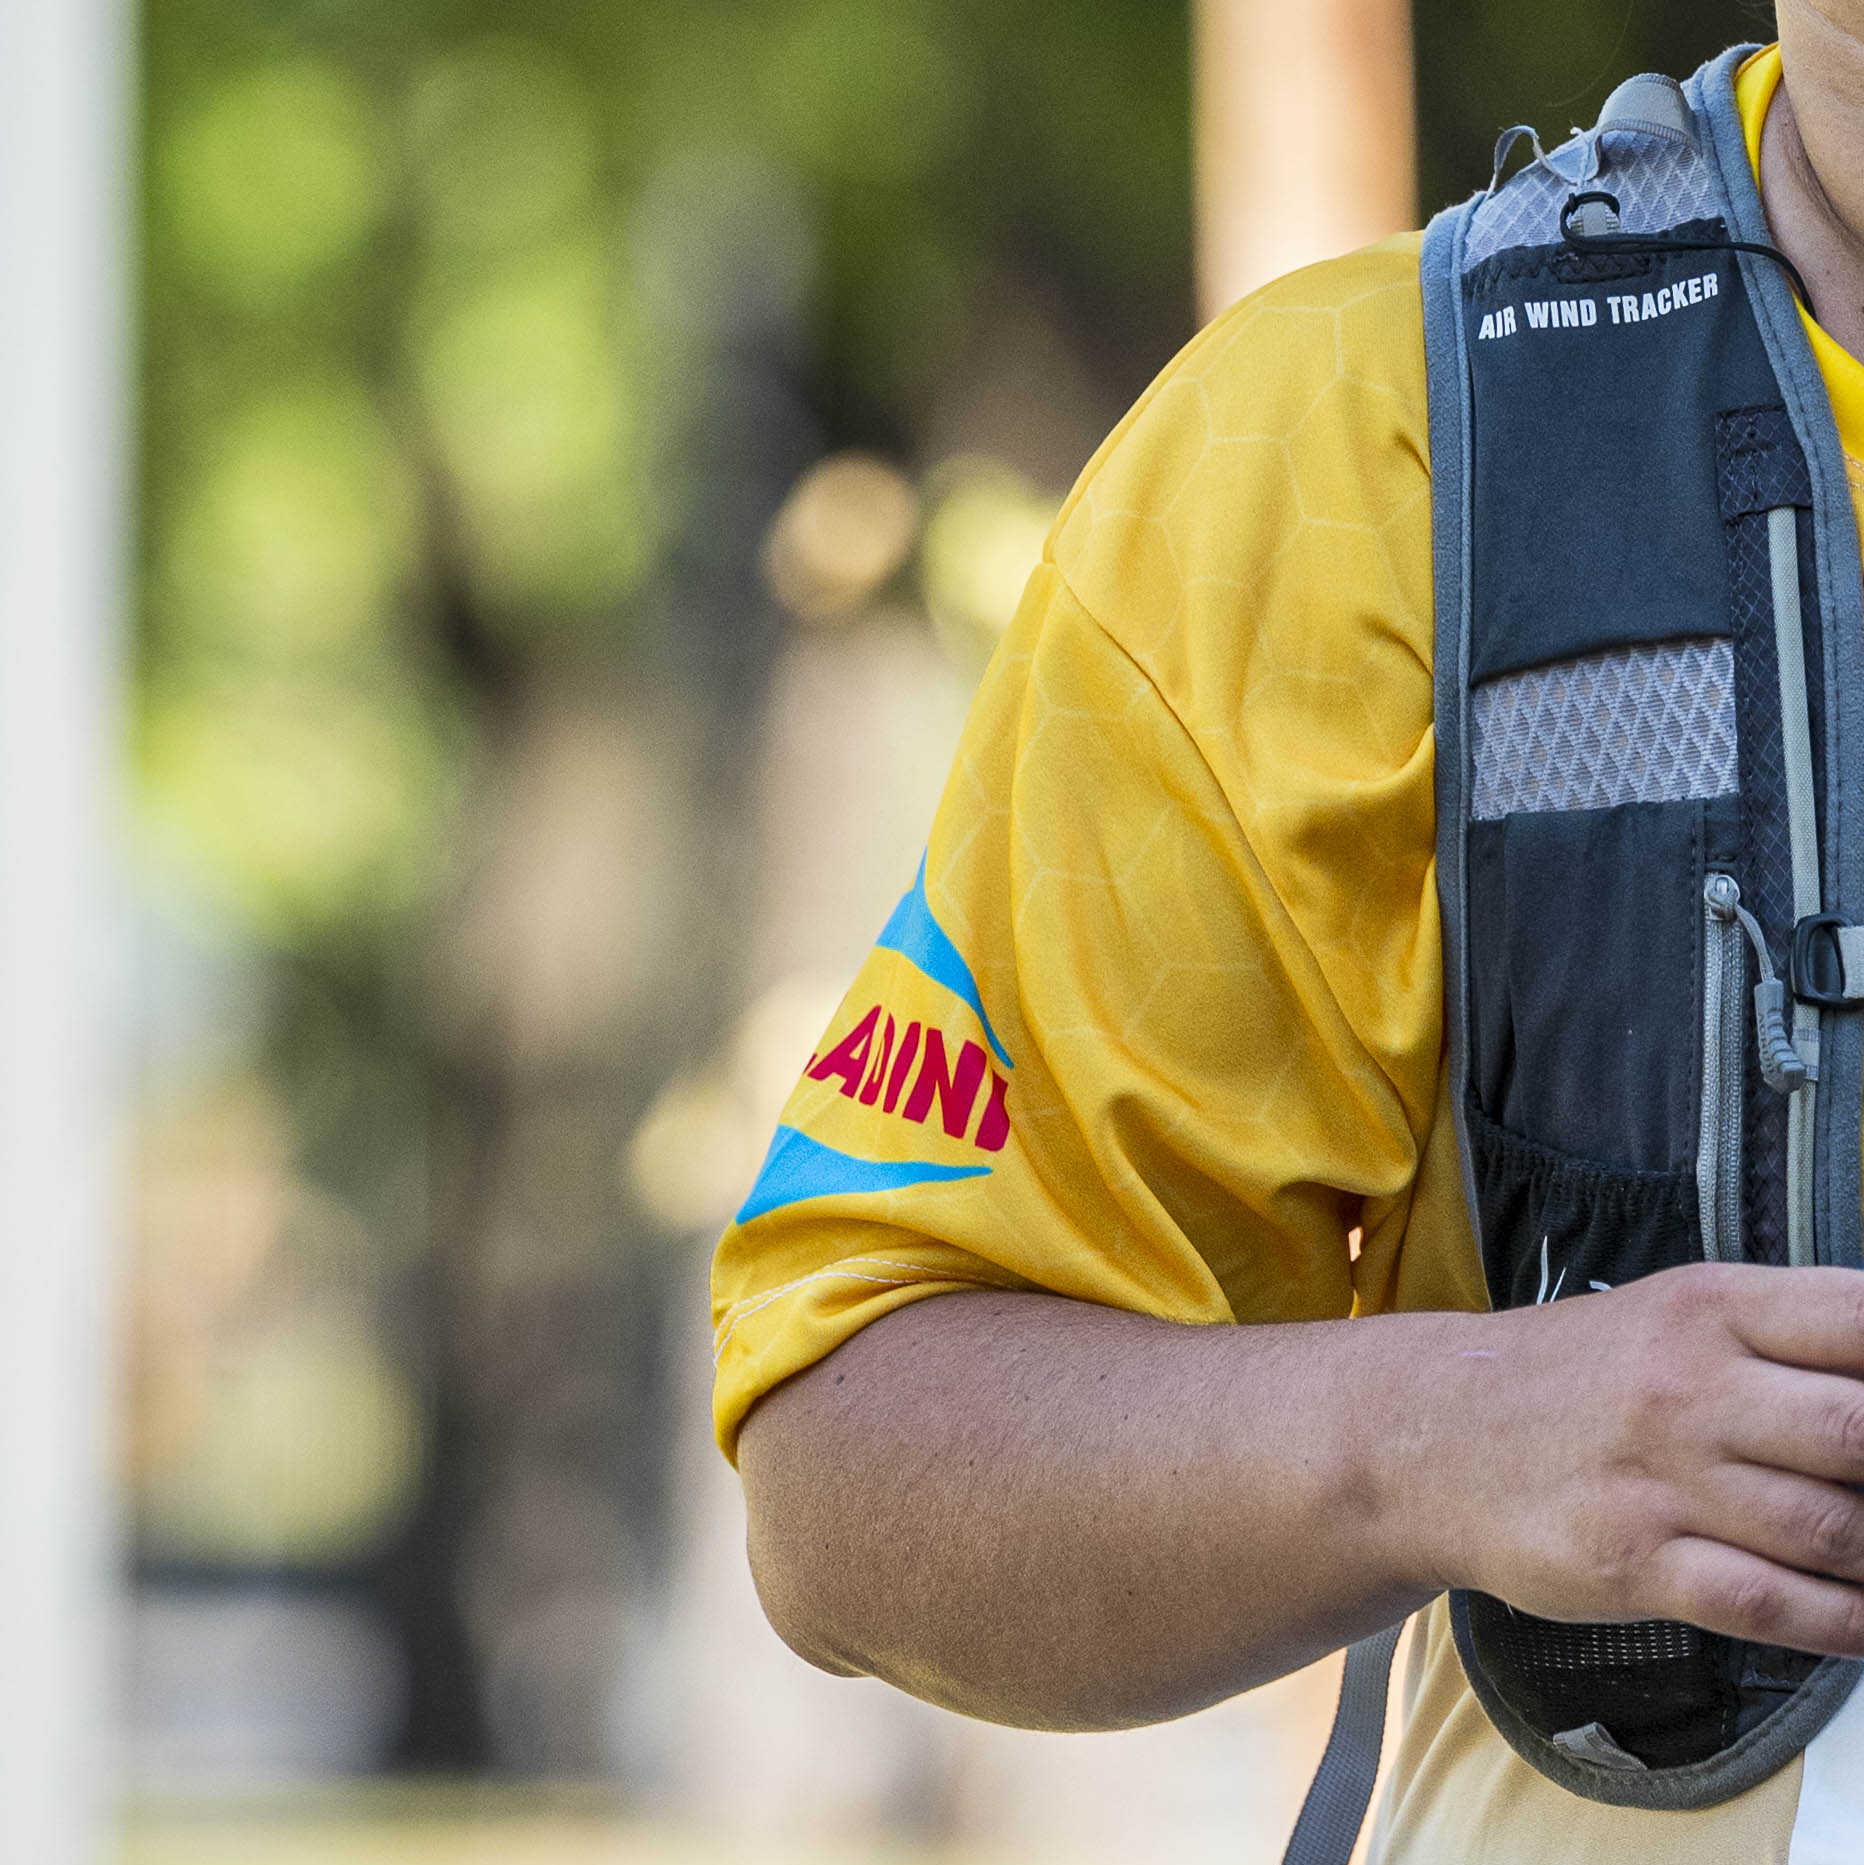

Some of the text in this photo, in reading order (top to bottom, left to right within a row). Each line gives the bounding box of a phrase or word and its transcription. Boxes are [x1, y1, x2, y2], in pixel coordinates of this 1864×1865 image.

[1478, 272, 1719, 340] AIR WIND TRACKER
[803, 1005, 1011, 1153] ADINI
